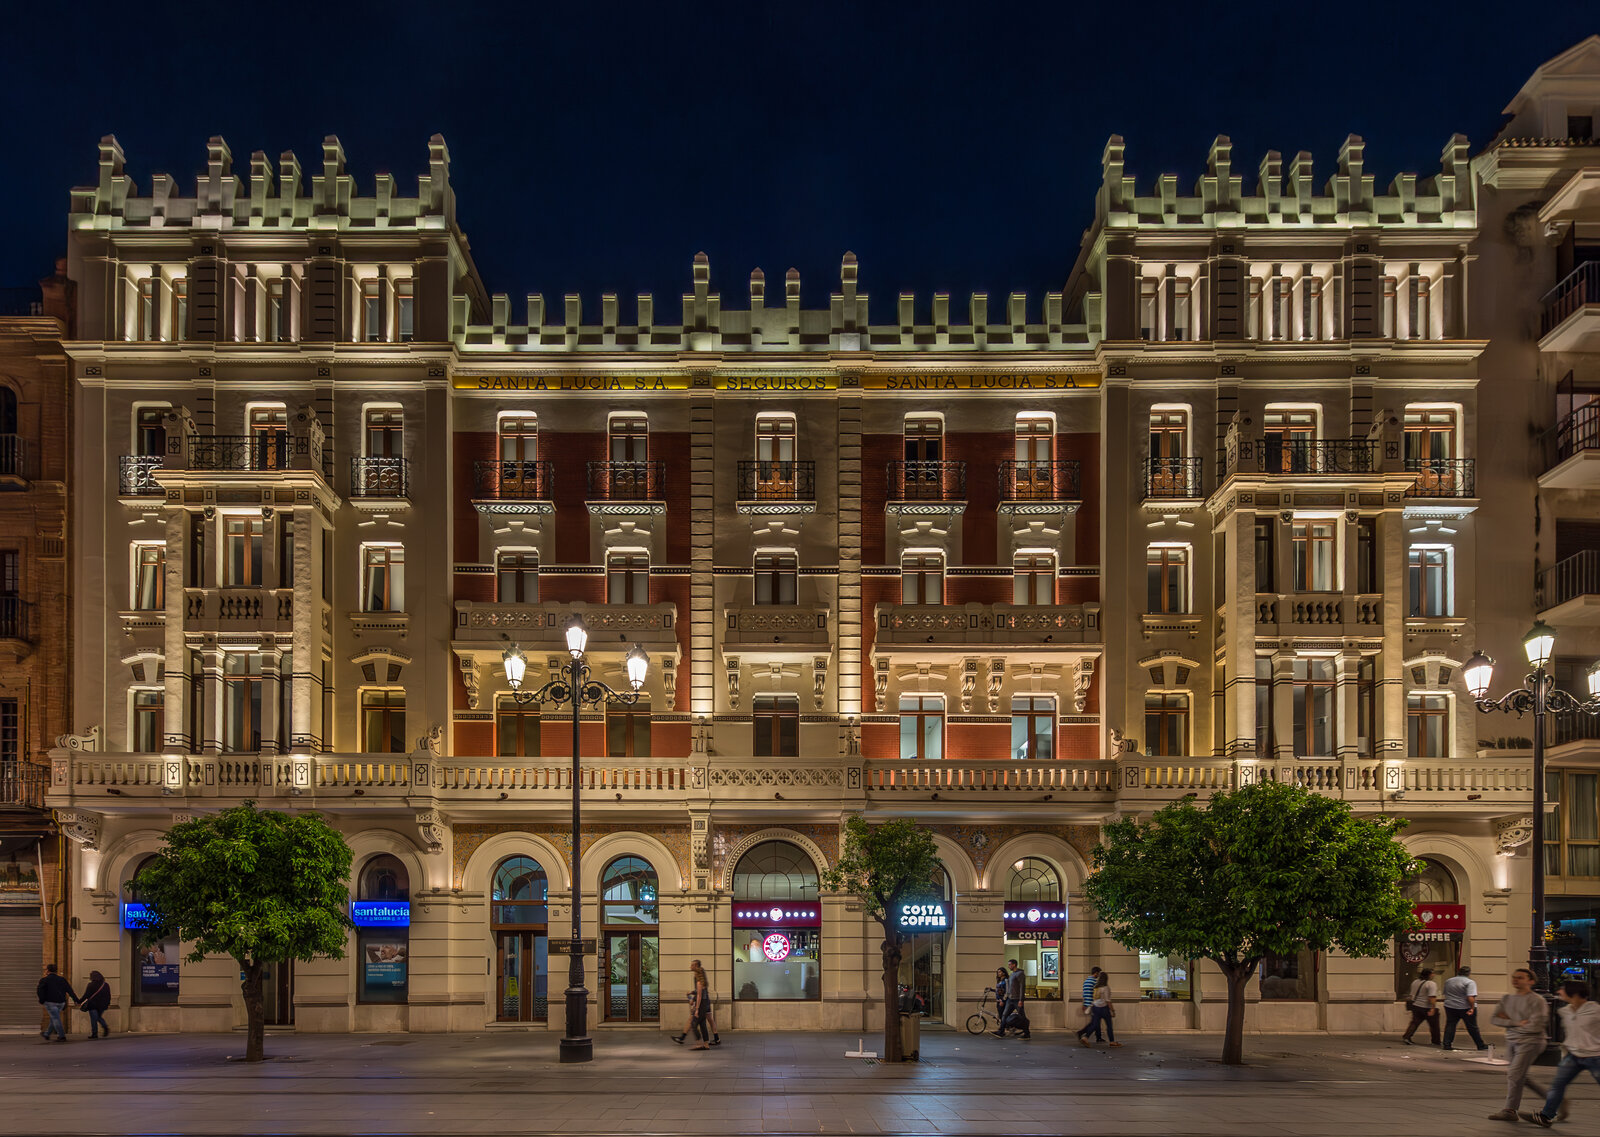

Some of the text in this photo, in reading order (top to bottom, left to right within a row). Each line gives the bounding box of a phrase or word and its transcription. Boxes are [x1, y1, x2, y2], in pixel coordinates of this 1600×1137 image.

[479, 376, 547, 389] SANTA
[727, 376, 826, 390] SEGUROS
[886, 375, 958, 388] SANTA
[902, 904, 943, 916] COSTA
[900, 915, 946, 926] COFFEE
[1018, 931, 1050, 940] COSTA
[1408, 933, 1451, 942] COFFEE
